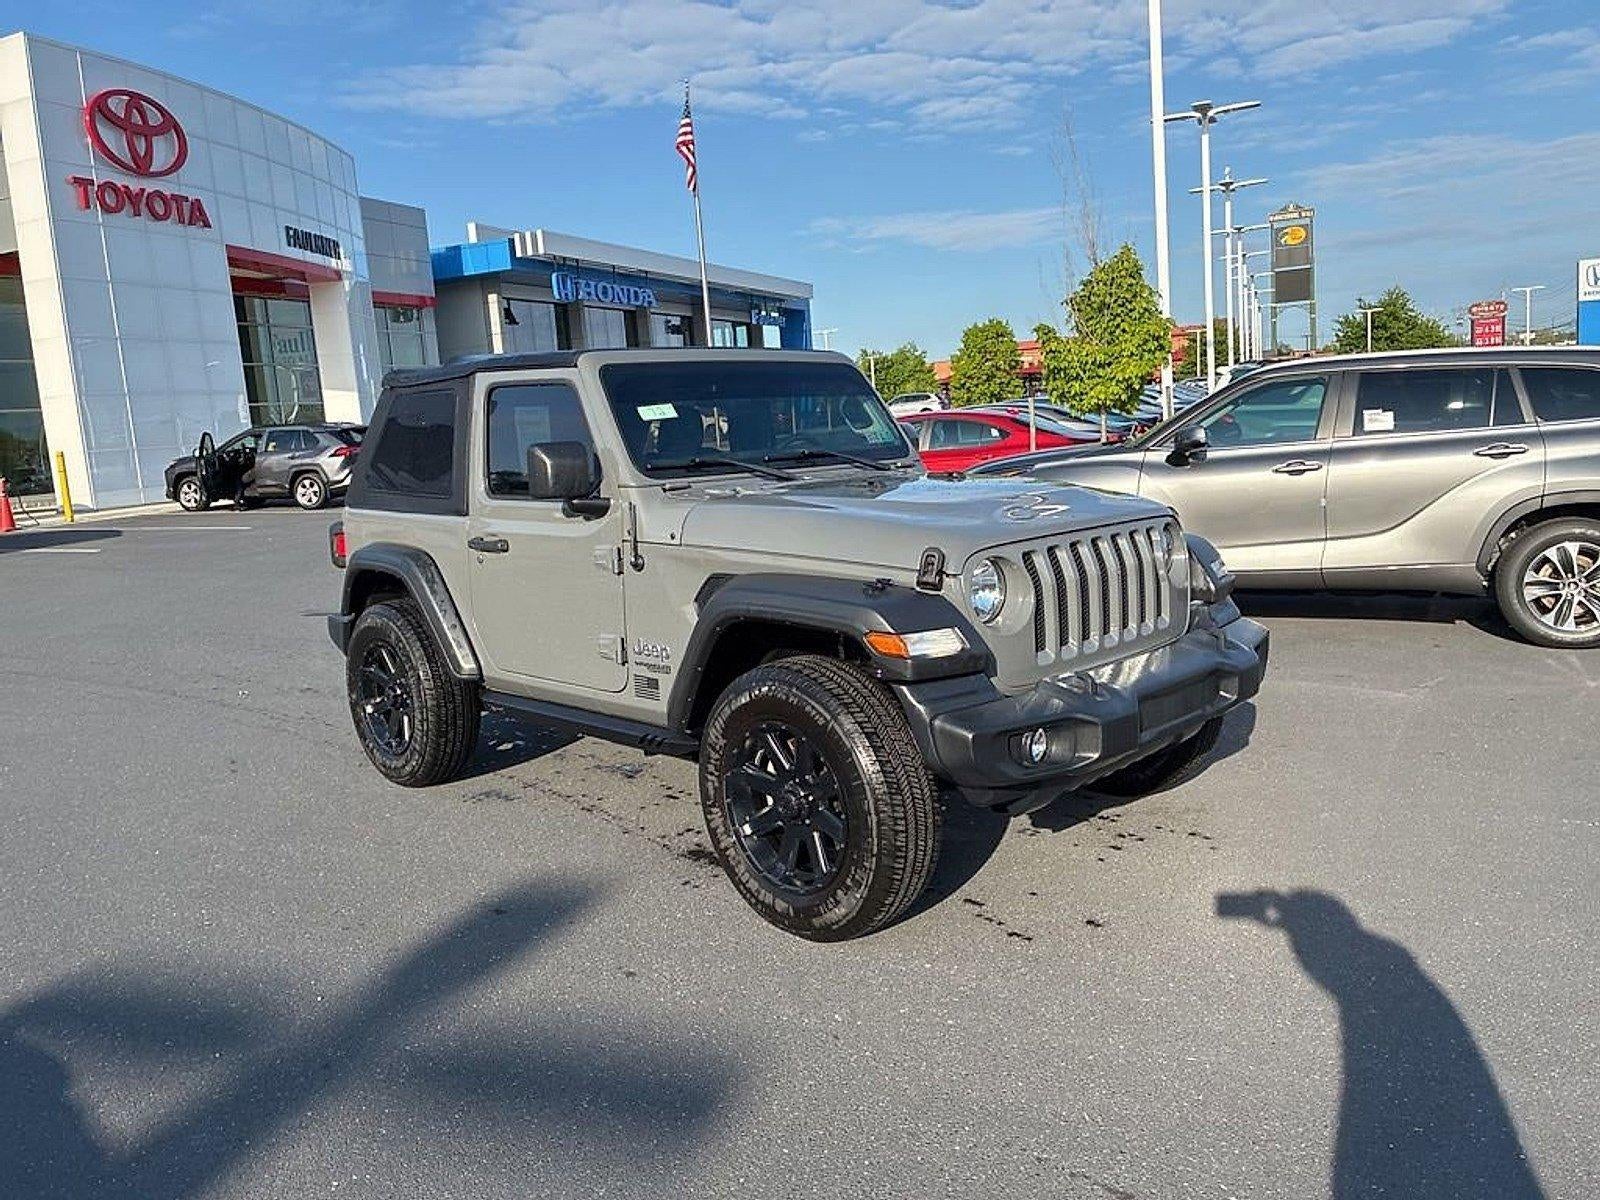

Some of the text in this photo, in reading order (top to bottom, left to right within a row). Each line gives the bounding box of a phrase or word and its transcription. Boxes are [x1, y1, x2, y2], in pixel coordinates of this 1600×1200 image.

[67, 175, 213, 228] TOYOTA
[577, 279, 658, 308] HONDA
[633, 638, 671, 662] Jeep
